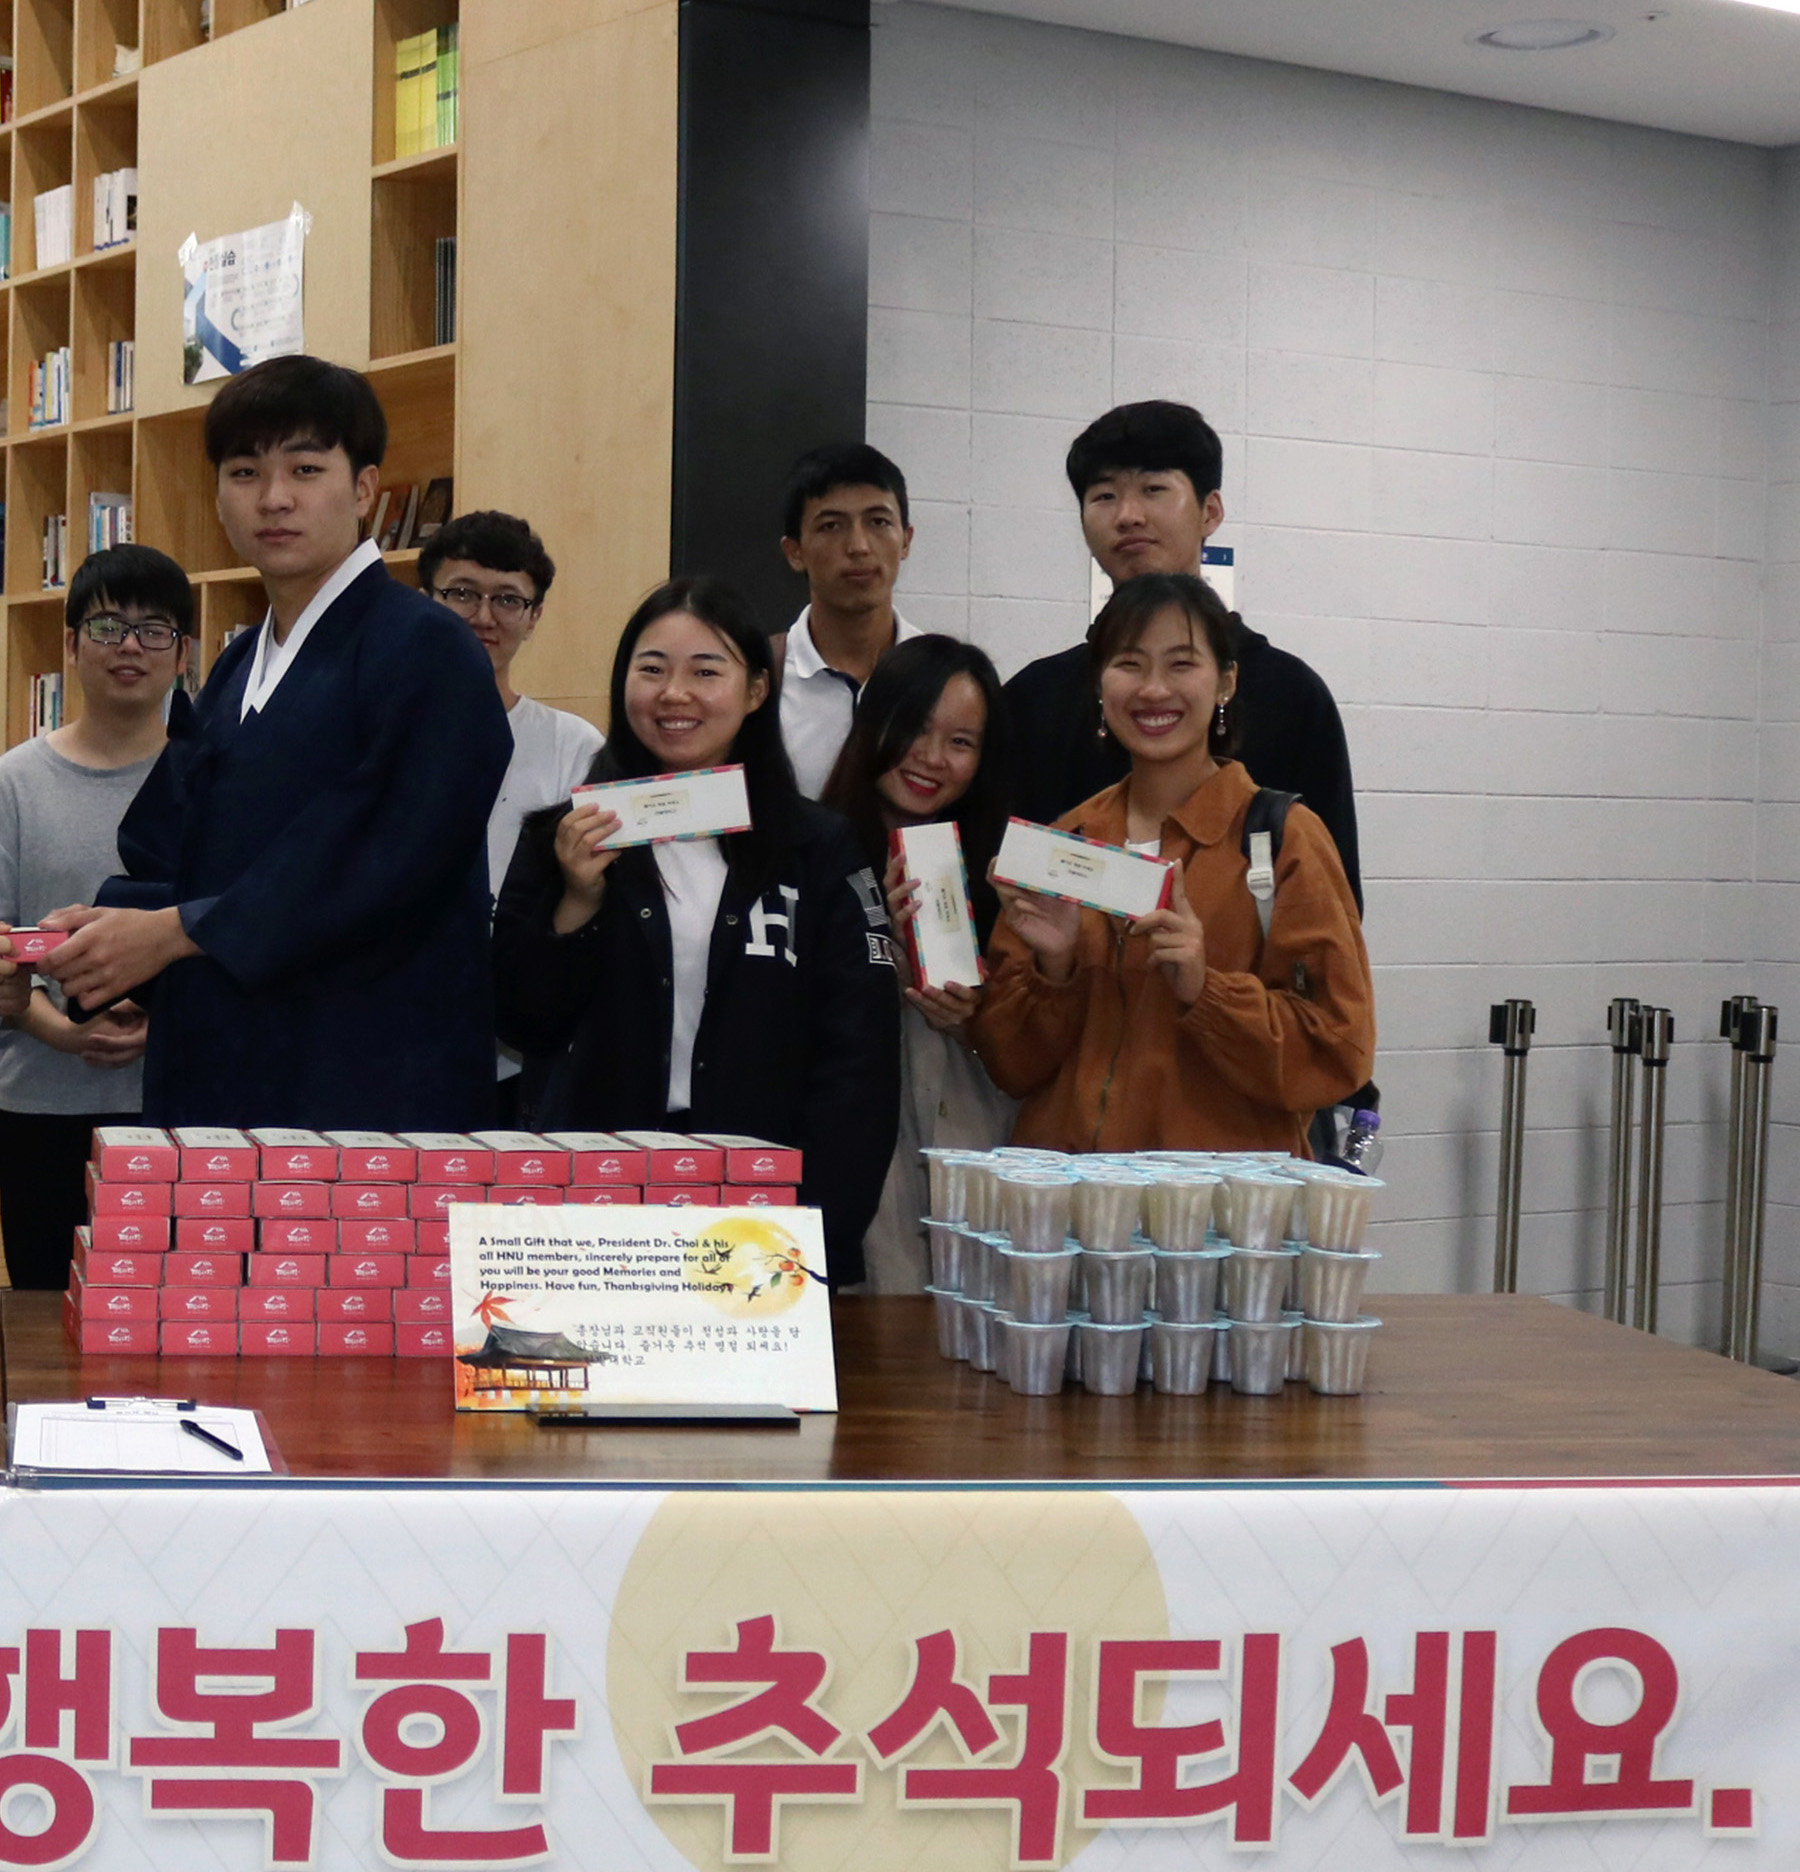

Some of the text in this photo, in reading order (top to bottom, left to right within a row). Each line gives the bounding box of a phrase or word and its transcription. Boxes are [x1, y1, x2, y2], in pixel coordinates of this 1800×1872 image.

[479, 1237, 487, 1246] A
[491, 1237, 521, 1246] Small
[524, 1237, 545, 1246] Gift
[549, 1238, 572, 1246] that
[598, 1238, 650, 1247] President
[654, 1238, 671, 1248] Dr.
[674, 1239, 698, 1248] Choi
[479, 1251, 493, 1260] all
[497, 1252, 524, 1260] HNU
[527, 1252, 581, 1262] members,
[585, 1252, 633, 1263] sincerely
[636, 1254, 680, 1263] prepare
[683, 1253, 698, 1262] for
[702, 1253, 716, 1262] all
[480, 1266, 681, 1277] you will be your good Memories and
[480, 1281, 542, 1291] Happiness.
[545, 1281, 575, 1290] Have
[578, 1281, 600, 1291] fun,
[604, 1282, 679, 1292] Thanksgiving
